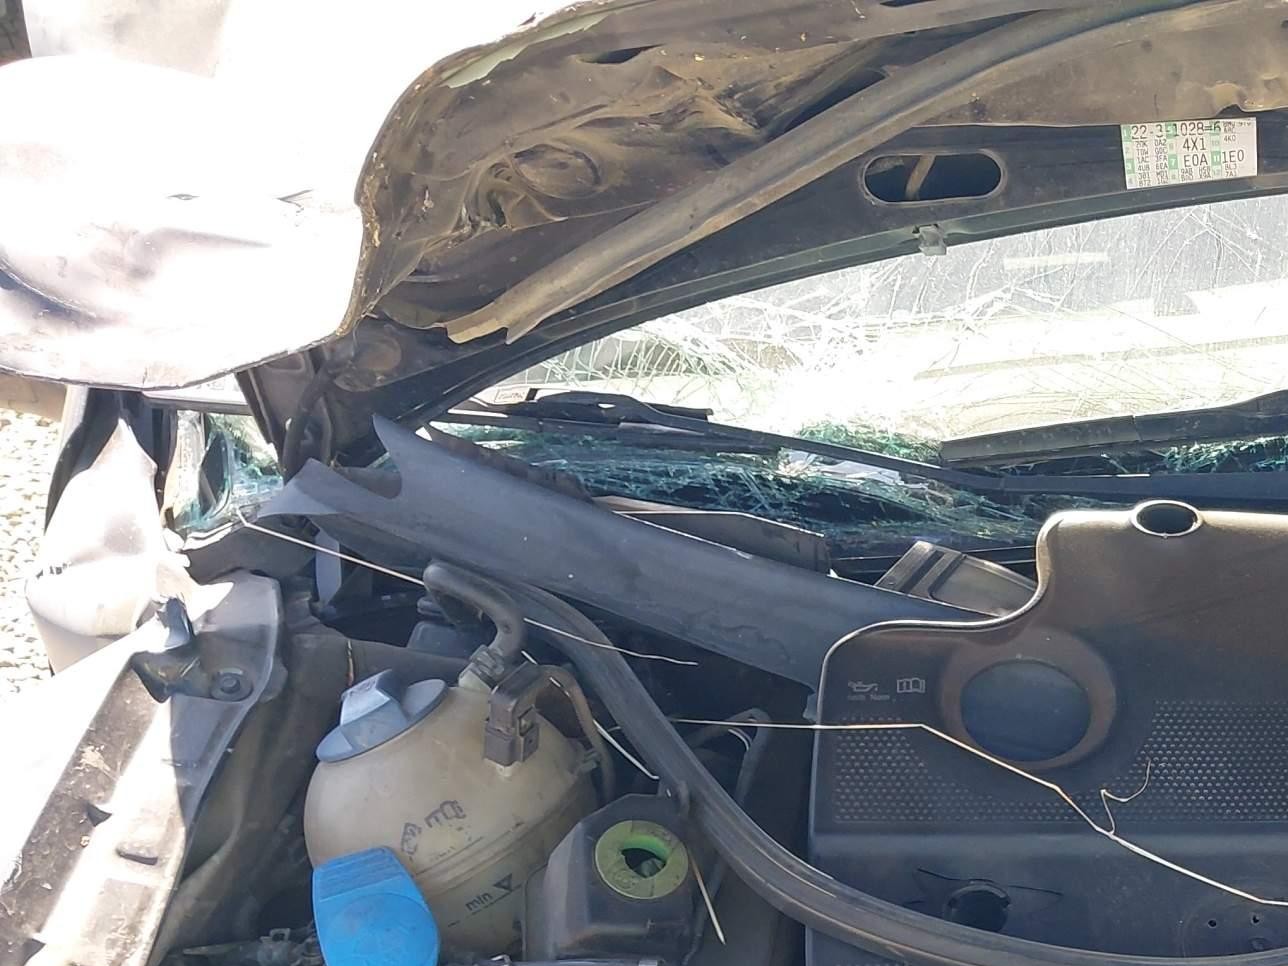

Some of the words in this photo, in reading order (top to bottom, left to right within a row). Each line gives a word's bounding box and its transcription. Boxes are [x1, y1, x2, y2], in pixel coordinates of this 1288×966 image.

[1182, 137, 1206, 152] 4X1
[1184, 153, 1209, 168] E0A
[1221, 149, 1245, 164] 1E0
[465, 892, 494, 912] min
